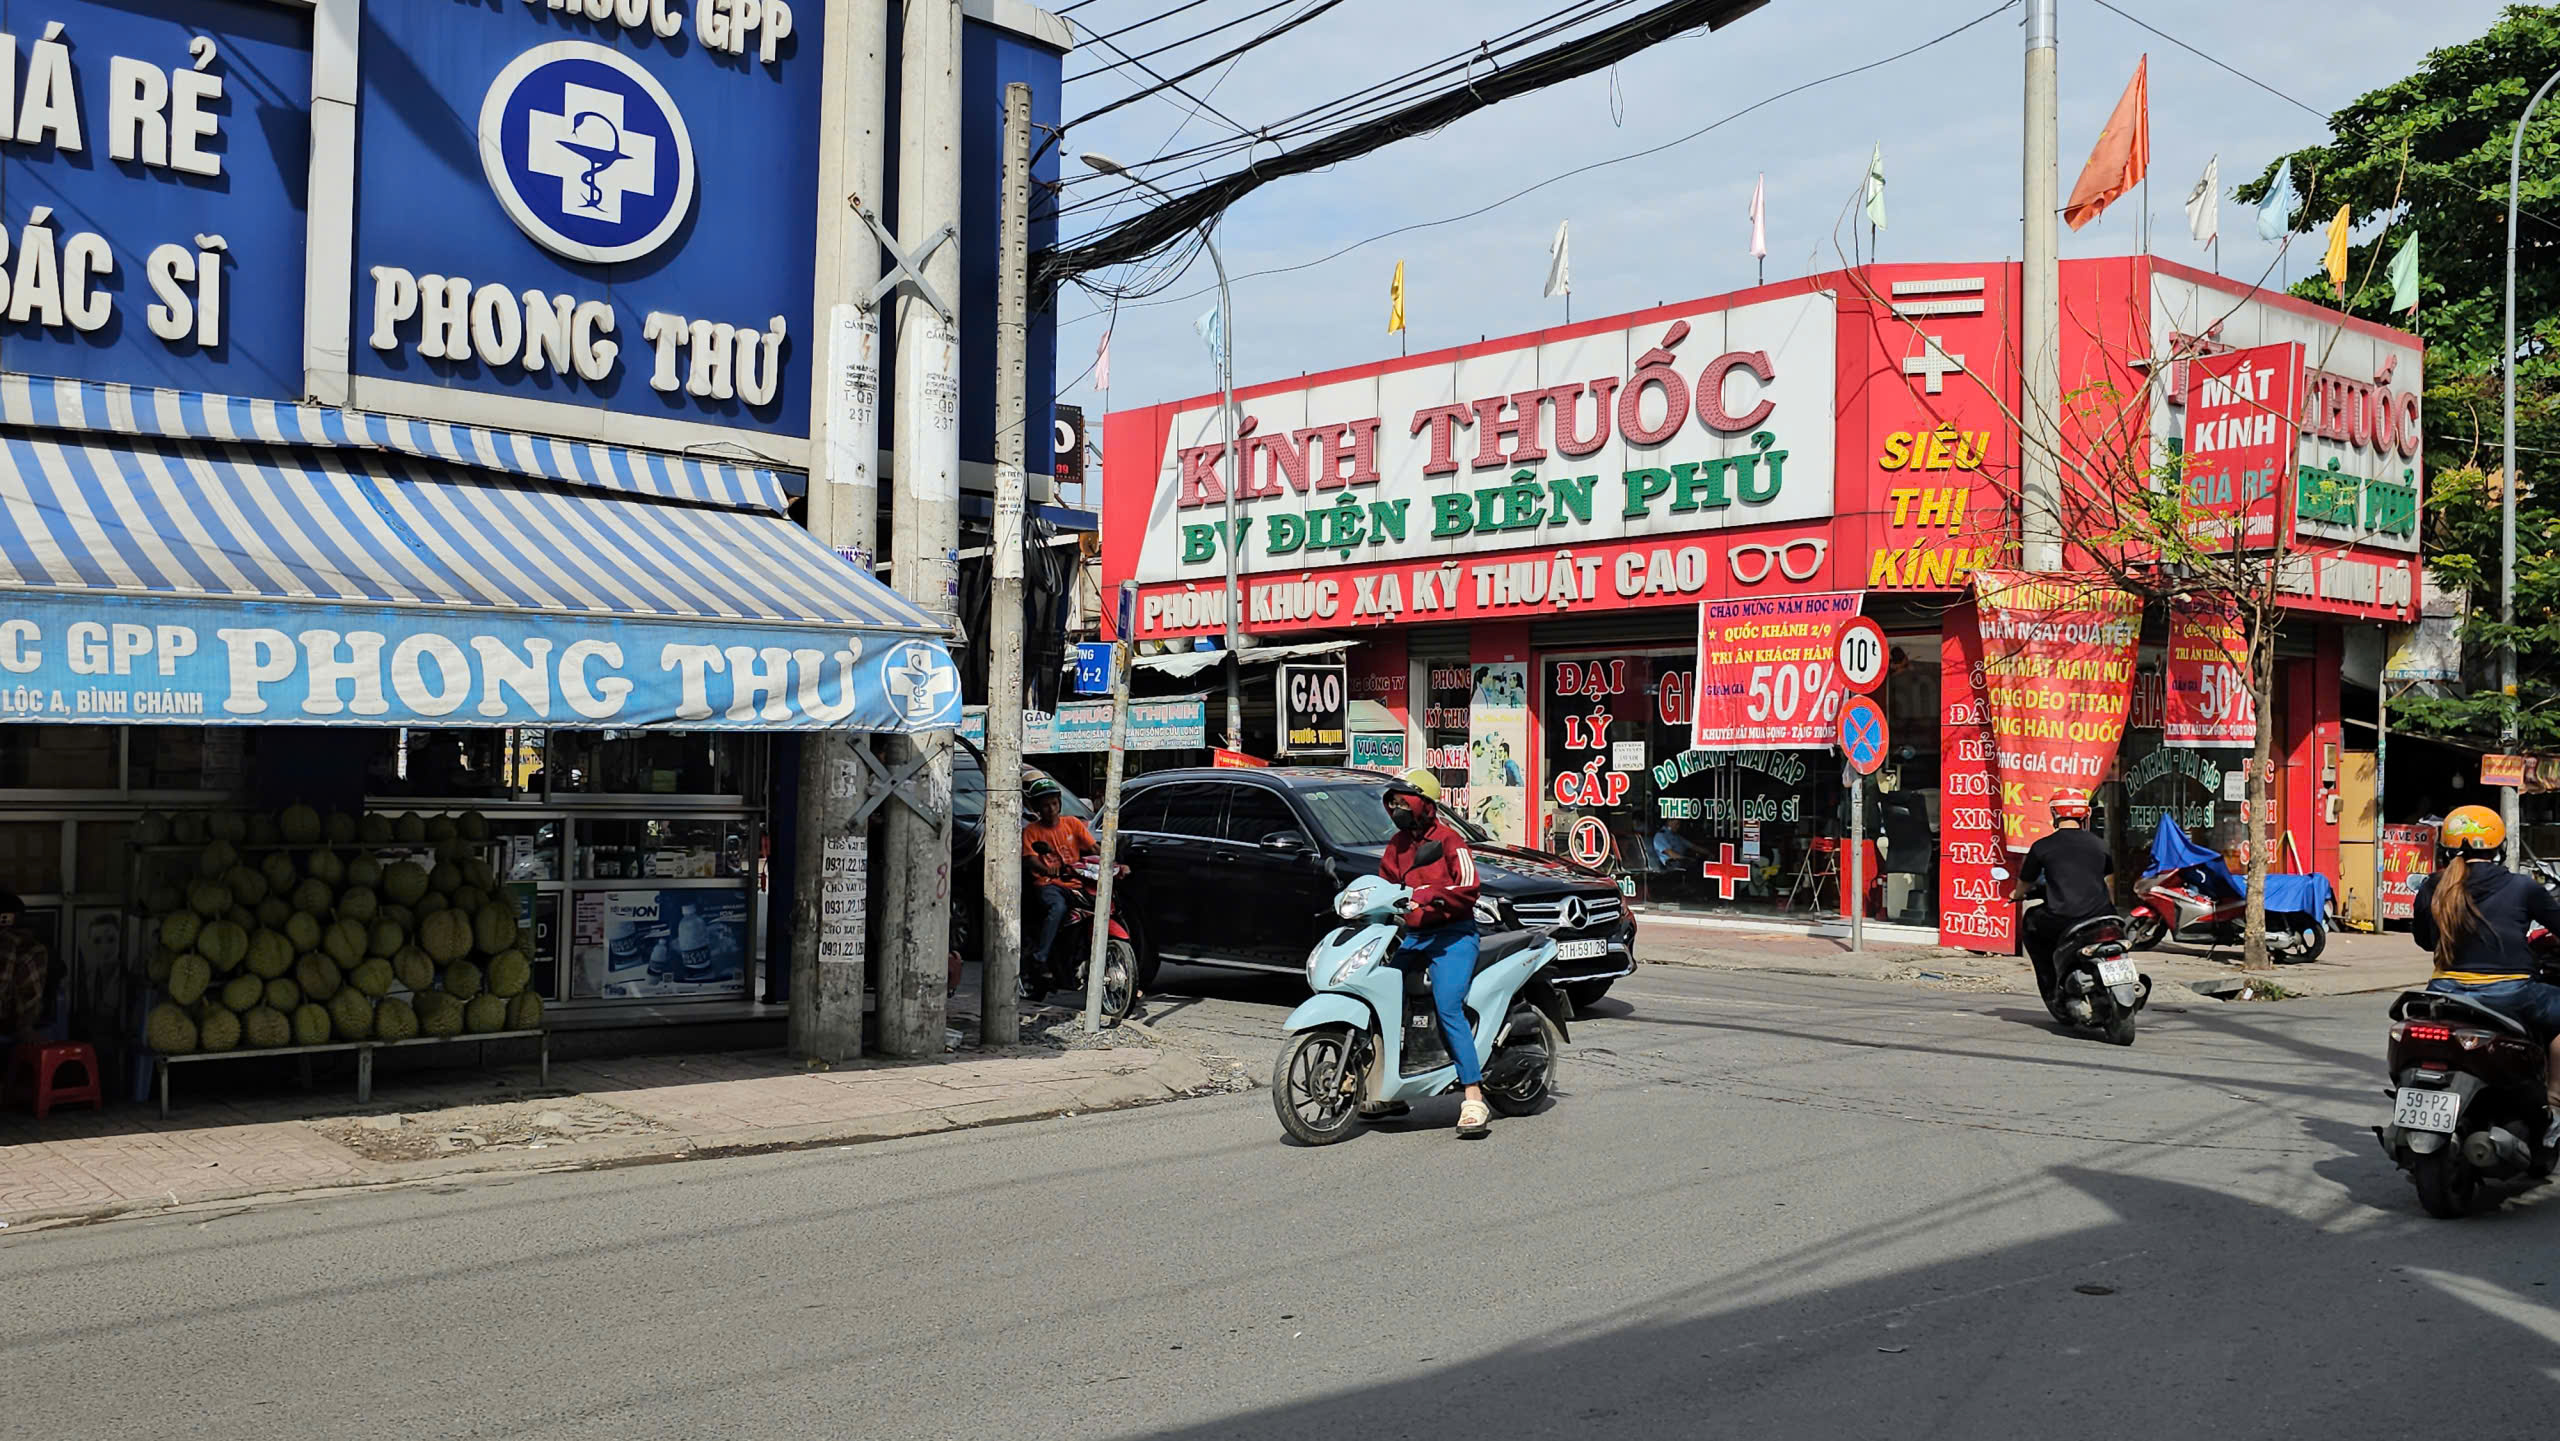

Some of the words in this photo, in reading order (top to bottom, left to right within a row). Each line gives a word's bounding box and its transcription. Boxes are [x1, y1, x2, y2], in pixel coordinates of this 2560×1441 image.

[109, 36, 223, 177] RẺ
[0, 205, 113, 333] ÁC
[146, 233, 228, 349] SĨ
[370, 266, 620, 383] PHONG
[644, 311, 788, 407] THƯ
[2201, 360, 2275, 409] MẮT
[1177, 415, 1381, 508] KÍNH
[1410, 320, 1776, 476] THUỐC
[1879, 421, 1991, 472] SIÊU
[2194, 413, 2276, 453] KÍNH
[1266, 492, 1410, 560] ĐIỆN
[1431, 469, 1599, 538] BIÊN
[1622, 430, 1789, 517] PHỦ
[2189, 467, 2233, 507] GIÁ
[2243, 457, 2275, 501] RẺ
[1890, 487, 1970, 538] THỊ
[1867, 536, 1985, 590] KÍNH
[1143, 583, 1243, 631] PHÒNG
[1251, 573, 1339, 624] KHÚC
[1352, 573, 1404, 620] XẠ
[1413, 560, 1463, 612] KỸ
[1471, 549, 1603, 609] THUẬT
[1615, 546, 1707, 598] CAO
[1804, 598, 1830, 616] HỌC
[1724, 622, 1759, 642] QUỐC
[1761, 620, 1809, 637] KHÁNH
[1811, 624, 1832, 638] 2/9
[1078, 649, 1094, 660] NG
[1711, 651, 1732, 664] TRI
[1755, 646, 1801, 662] KHÁCH
[66, 621, 198, 676] GPP
[217, 628, 634, 719] PHONG
[660, 636, 863, 722] THƯ
[1556, 660, 1625, 702] ĐẠI
[2055, 659, 2099, 682] NAM
[77, 685, 127, 714] BÌNH
[134, 688, 203, 714] CHÁNH
[1291, 673, 1340, 724] GẠO
[1659, 671, 1693, 725] GI
[1747, 661, 1839, 722] 50%
[1987, 688, 2023, 711] ỌNG
[2068, 692, 2124, 714] TITAN
[2129, 653, 2165, 729] GIẢ
[1444, 708, 1470, 728] THU
[1564, 705, 1613, 749] LÝ
[2024, 716, 2064, 739] HÀN
[2068, 717, 2123, 744] QUỐC
[1380, 740, 1401, 760] GẠO
[1444, 742, 1470, 769] KHÁ
[2022, 751, 2047, 773] GIÁ
[1554, 755, 1630, 805] CẤP
[2002, 782, 2025, 807] K
[1658, 798, 1702, 819] THEO
[1742, 793, 1778, 821] BÁC
[1953, 808, 2003, 830] XIN
[2130, 805, 2157, 828] THEO
[1949, 835, 2006, 865] TRẢ
[1953, 878, 2001, 904] LẠI
[632, 906, 658, 918] ION
[1944, 905, 2010, 938] TIỀN
[2406, 1091, 2449, 1112] 59-P2
[2398, 1108, 2451, 1129] 239.93
